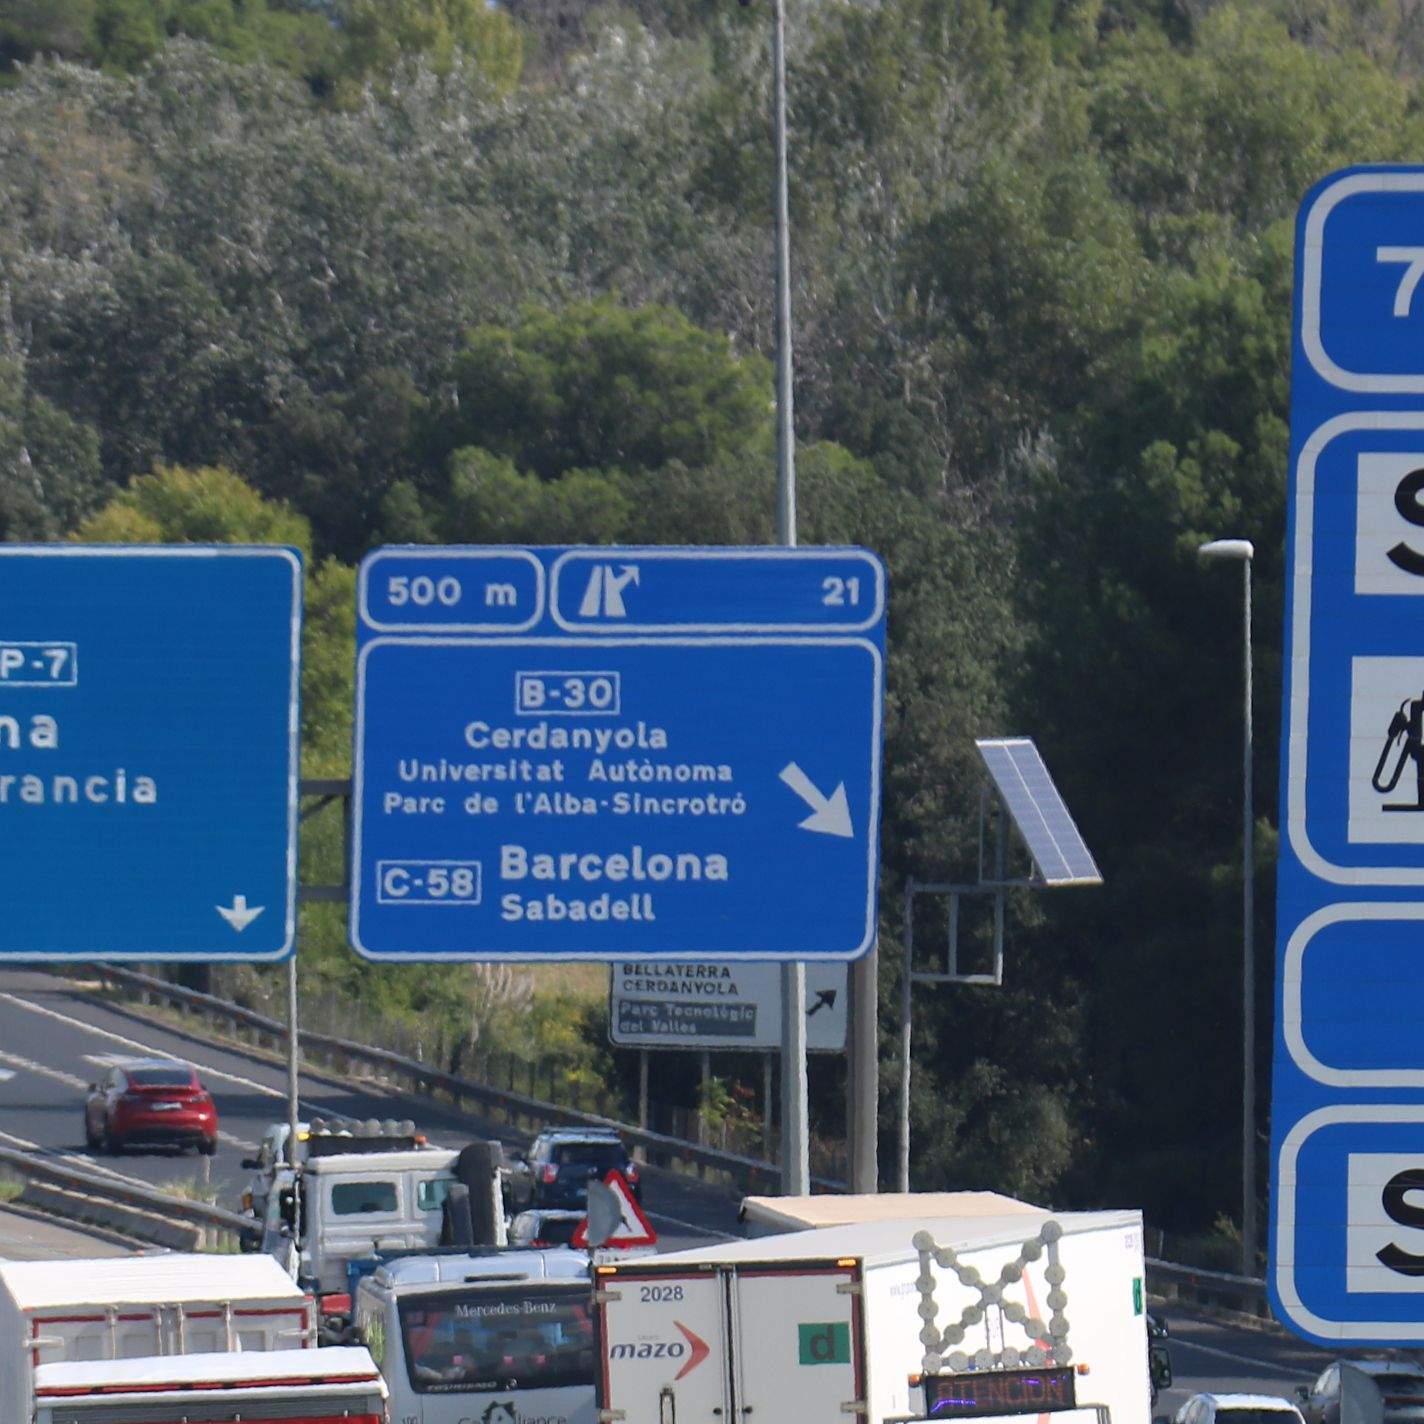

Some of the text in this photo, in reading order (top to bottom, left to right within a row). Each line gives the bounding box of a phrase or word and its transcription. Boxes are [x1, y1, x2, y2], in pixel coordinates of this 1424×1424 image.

[387, 576, 518, 606] 500 m
[821, 577, 860, 605] 21
[521, 678, 614, 708] B-30
[464, 721, 668, 754] Cerdanyola
[399, 758, 733, 783] Universitat Autònoma
[383, 792, 747, 816] Parc de l'Alba-Sincrotró
[499, 845, 729, 882] Barcelona
[383, 868, 474, 898] C-58
[500, 894, 656, 922] Sabadell
[623, 963, 732, 979] BELLATERRA
[623, 979, 739, 997] CERDANYOLA
[620, 1003, 658, 1018] Parc
[640, 1286, 684, 1302] 2028
[610, 1341, 685, 1360] mazo
[810, 1324, 834, 1362] d
